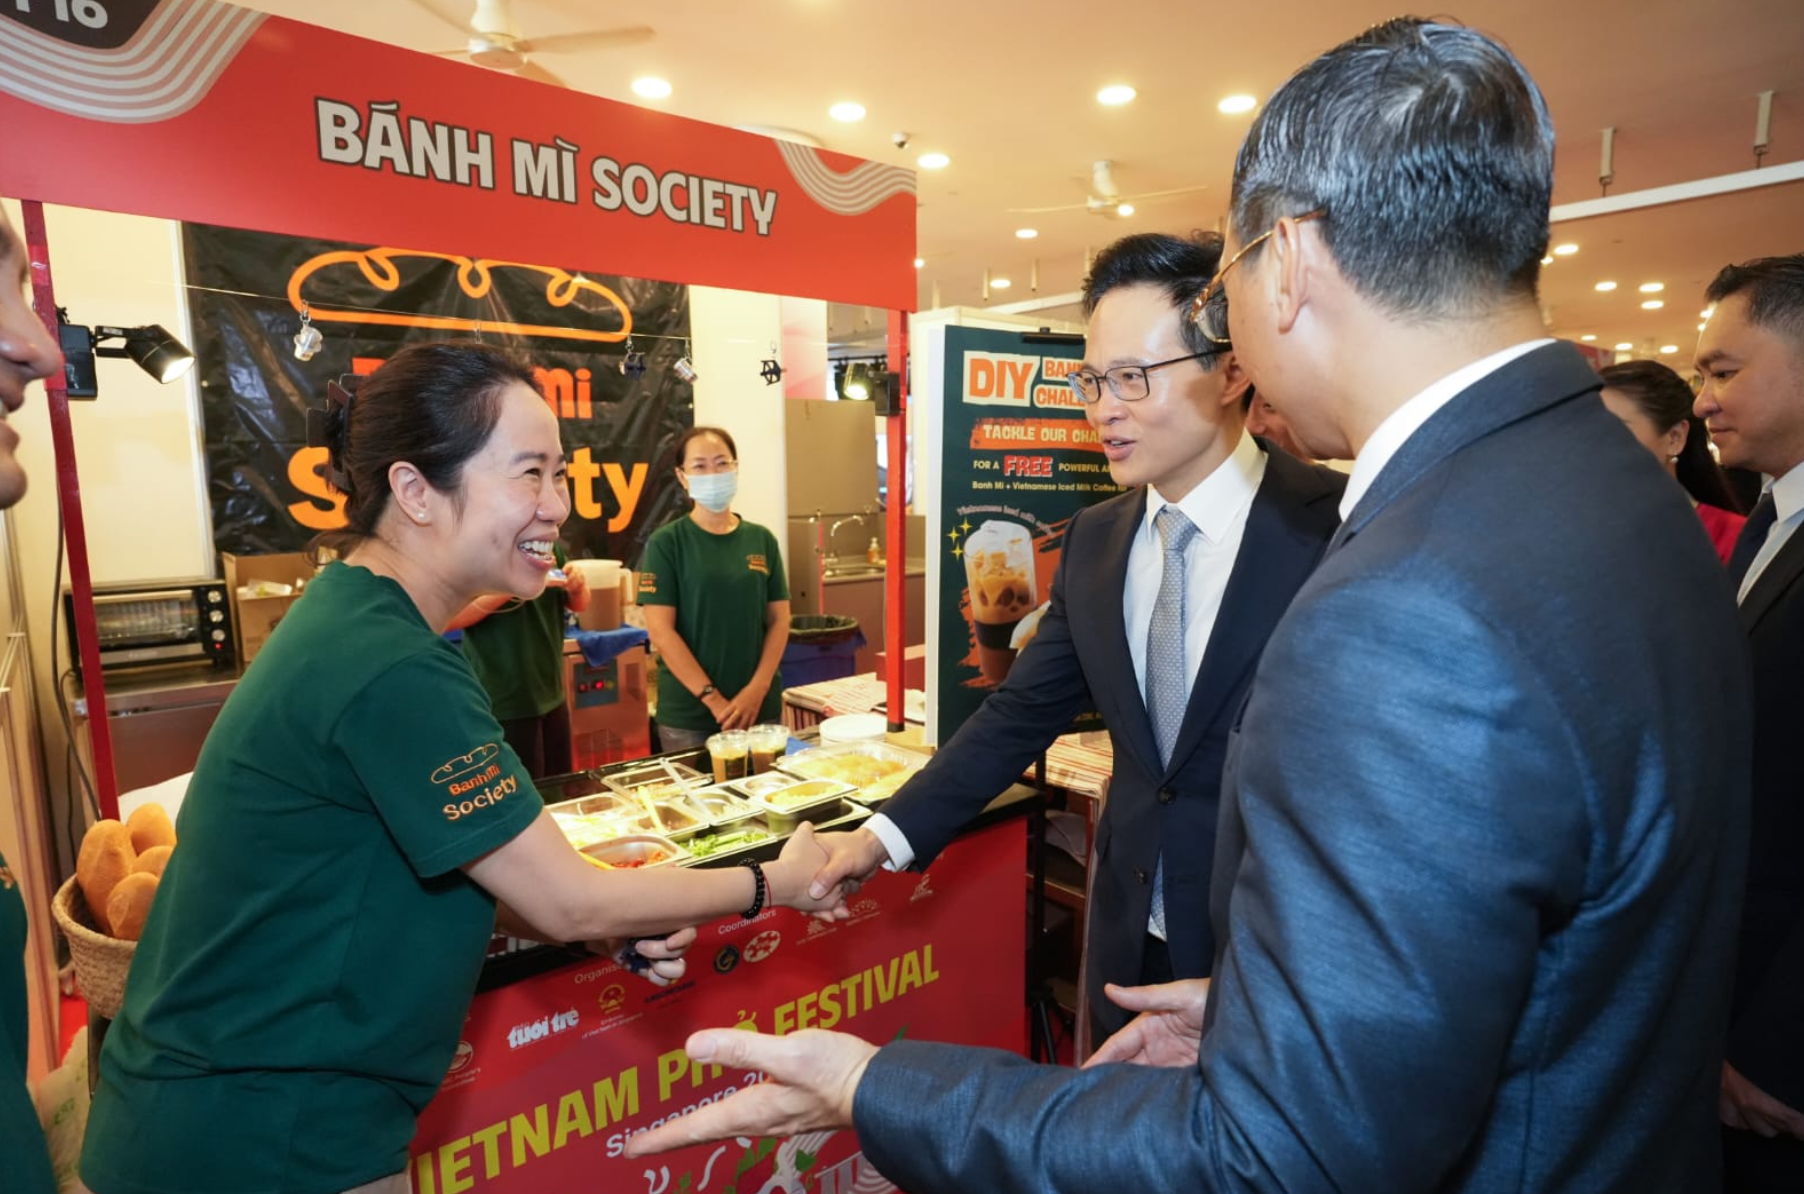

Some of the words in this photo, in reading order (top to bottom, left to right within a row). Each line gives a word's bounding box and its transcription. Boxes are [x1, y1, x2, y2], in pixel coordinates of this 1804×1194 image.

[315, 97, 494, 189] BÁNH
[511, 137, 579, 204] MÌ
[592, 155, 777, 236] SOCIETY
[968, 358, 1034, 400] DIY
[983, 424, 1035, 441] TACKLE
[1041, 427, 1067, 442] OUR
[1072, 429, 1100, 443] CHA
[973, 460, 991, 470] FOR
[992, 460, 1000, 470] A
[1003, 455, 1053, 477] FREE
[1058, 462, 1099, 473] POWERFUL
[972, 480, 993, 490] Banh
[1012, 481, 1057, 492] Vietnamese
[443, 775, 518, 820] Society
[448, 774, 487, 796] Banh
[416, 1066, 639, 1194] IETNAM
[774, 944, 940, 1036] FESTIVAL
